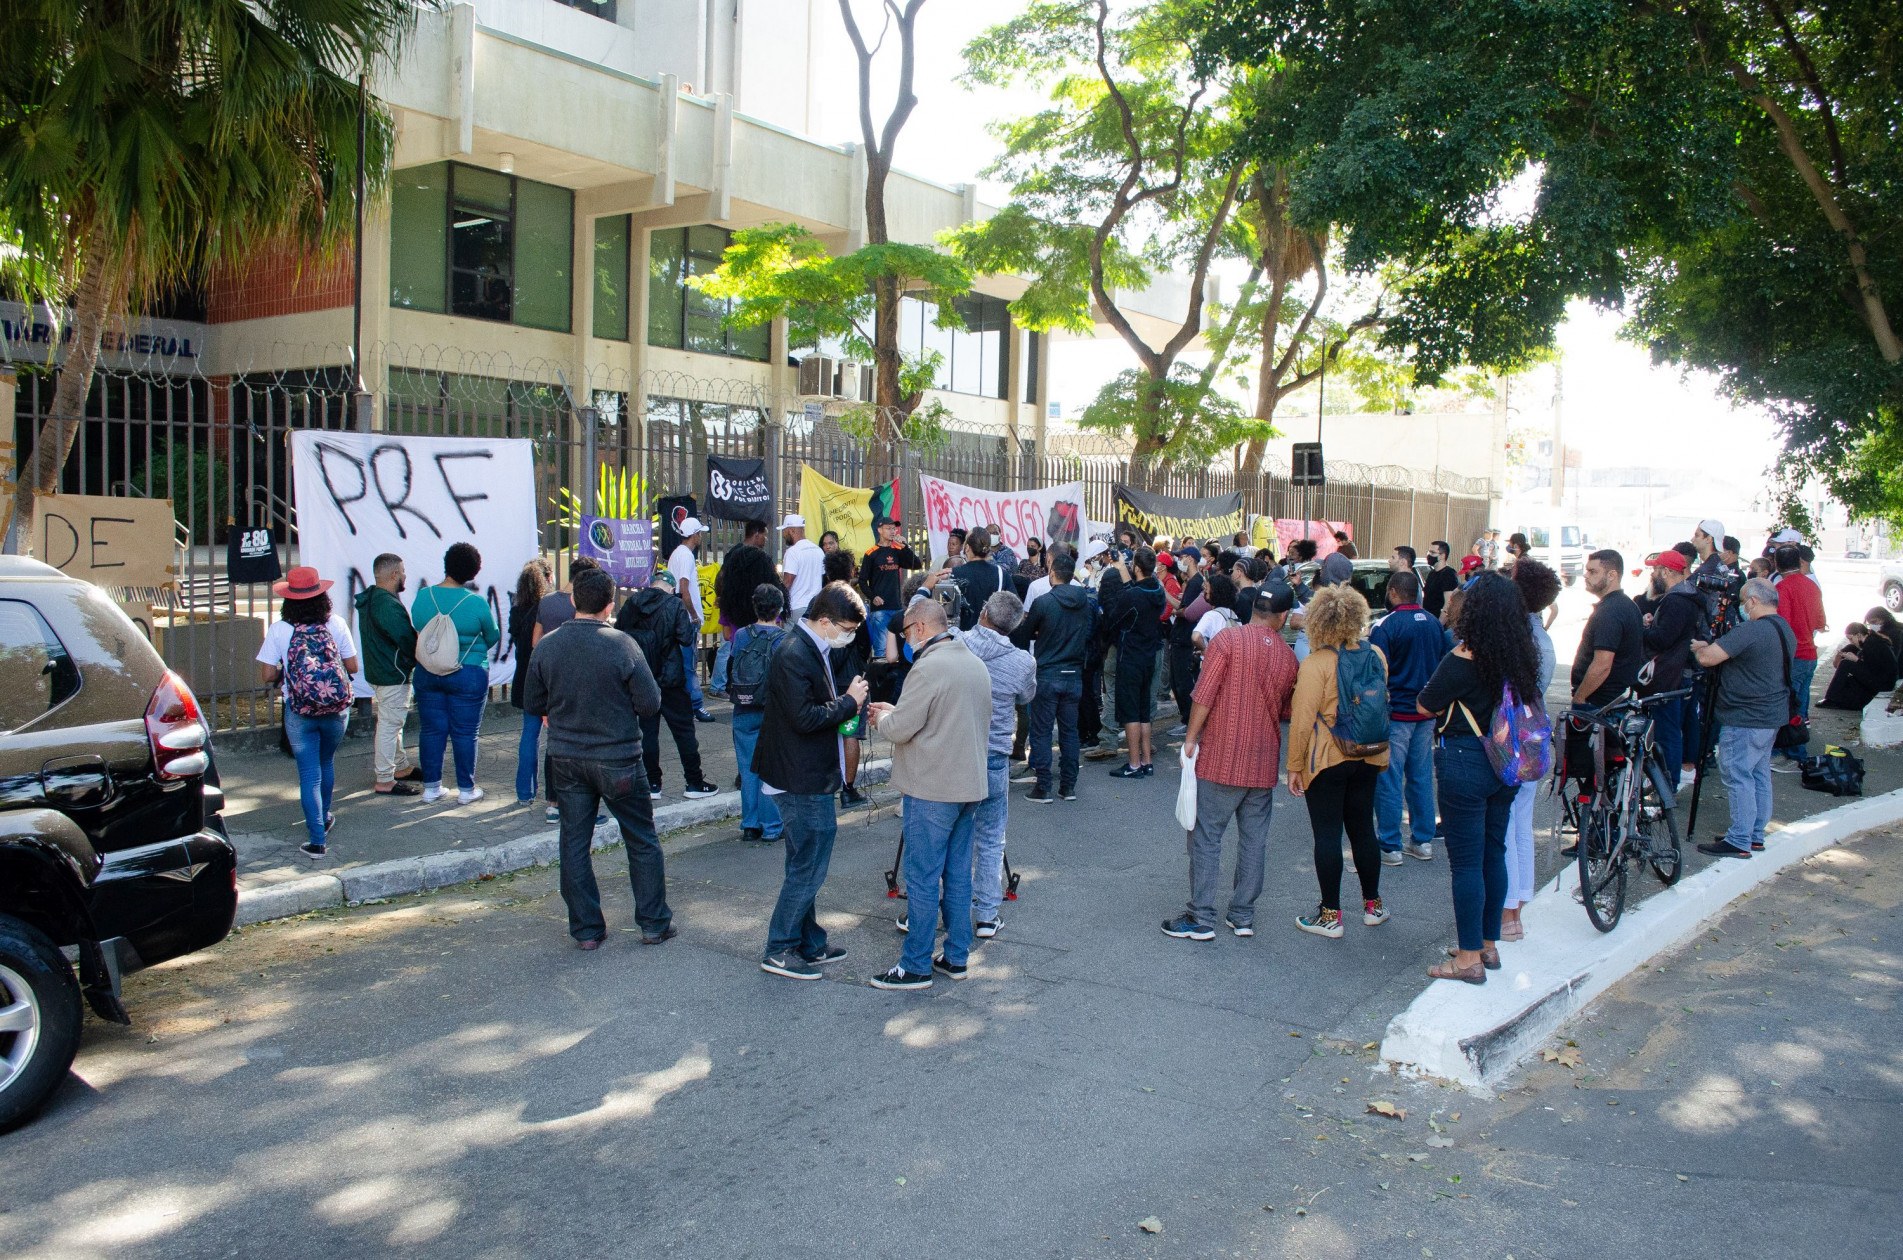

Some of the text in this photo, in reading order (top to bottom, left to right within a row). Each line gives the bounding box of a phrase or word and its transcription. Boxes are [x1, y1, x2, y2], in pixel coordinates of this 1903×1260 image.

[101, 330, 199, 358] EDERAL
[314, 442, 493, 540] PRF
[45, 513, 135, 569] DE
[252, 529, 269, 546] 80
[1166, 515, 1183, 539] DO
